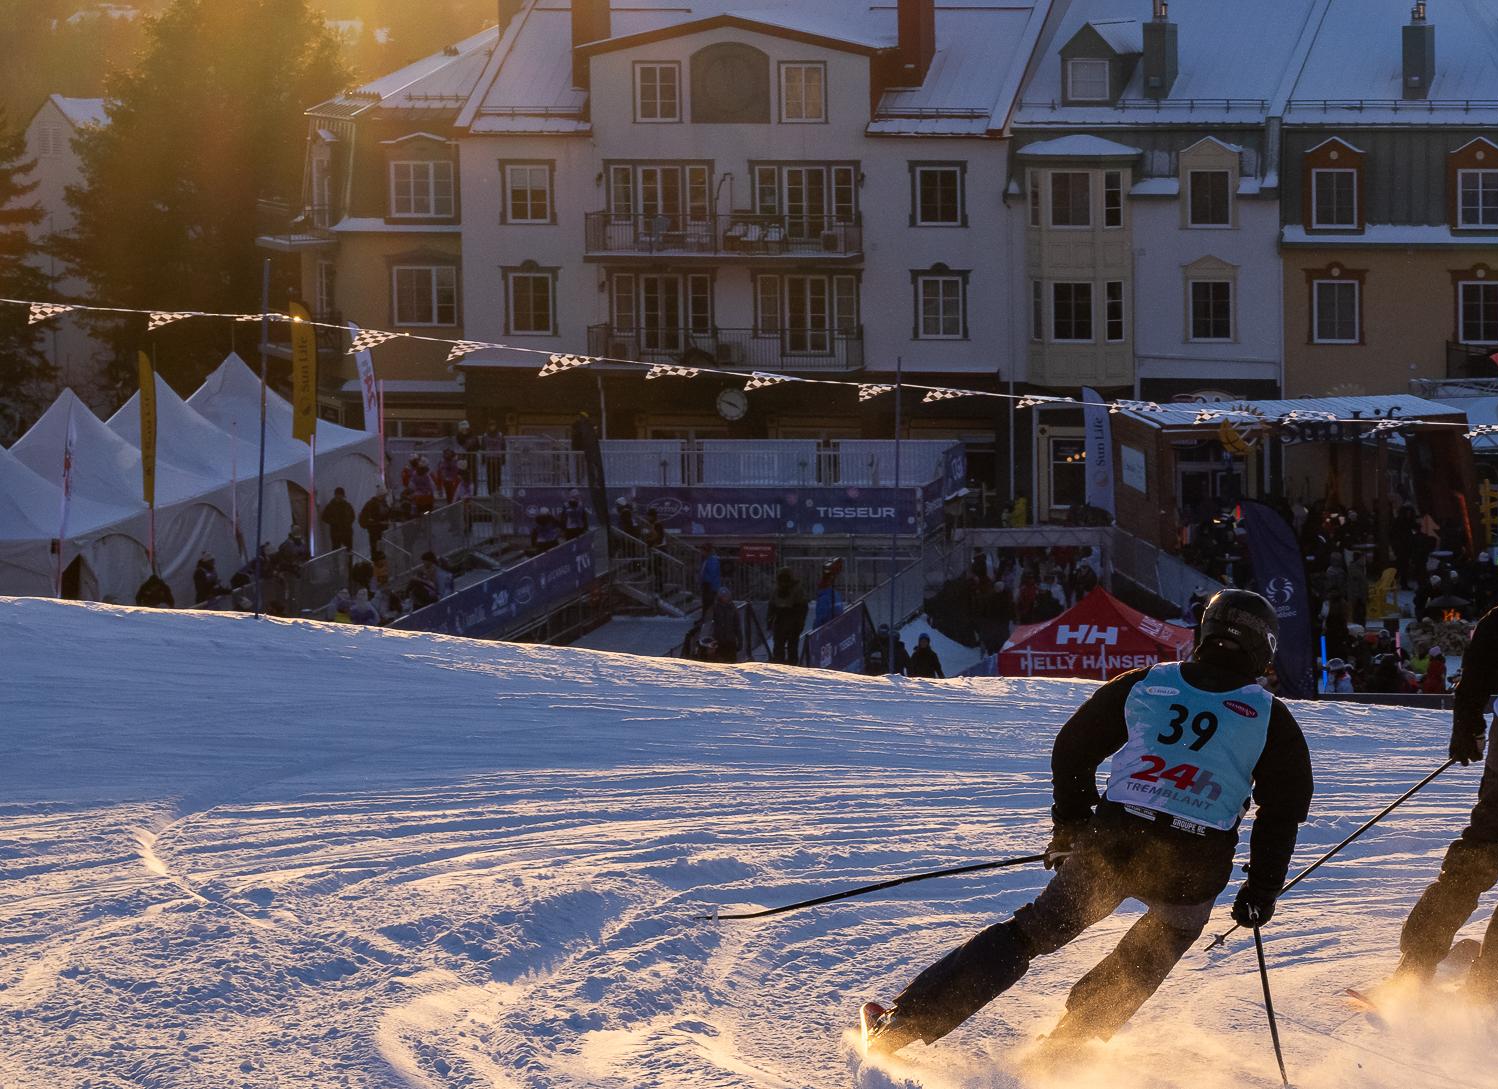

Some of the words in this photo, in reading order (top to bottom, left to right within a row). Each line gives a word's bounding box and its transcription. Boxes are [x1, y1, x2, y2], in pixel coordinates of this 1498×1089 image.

[1093, 417, 1105, 440] Life
[1096, 443, 1106, 467] Sun
[697, 503, 781, 519] MONTONI
[816, 507, 896, 518] TISSEUR
[1020, 654, 1078, 671] HELLY
[1082, 654, 1159, 670] HANSEN
[1157, 703, 1218, 752] 39
[1130, 755, 1222, 801] 24h
[1126, 781, 1214, 810] TREMBLANT
